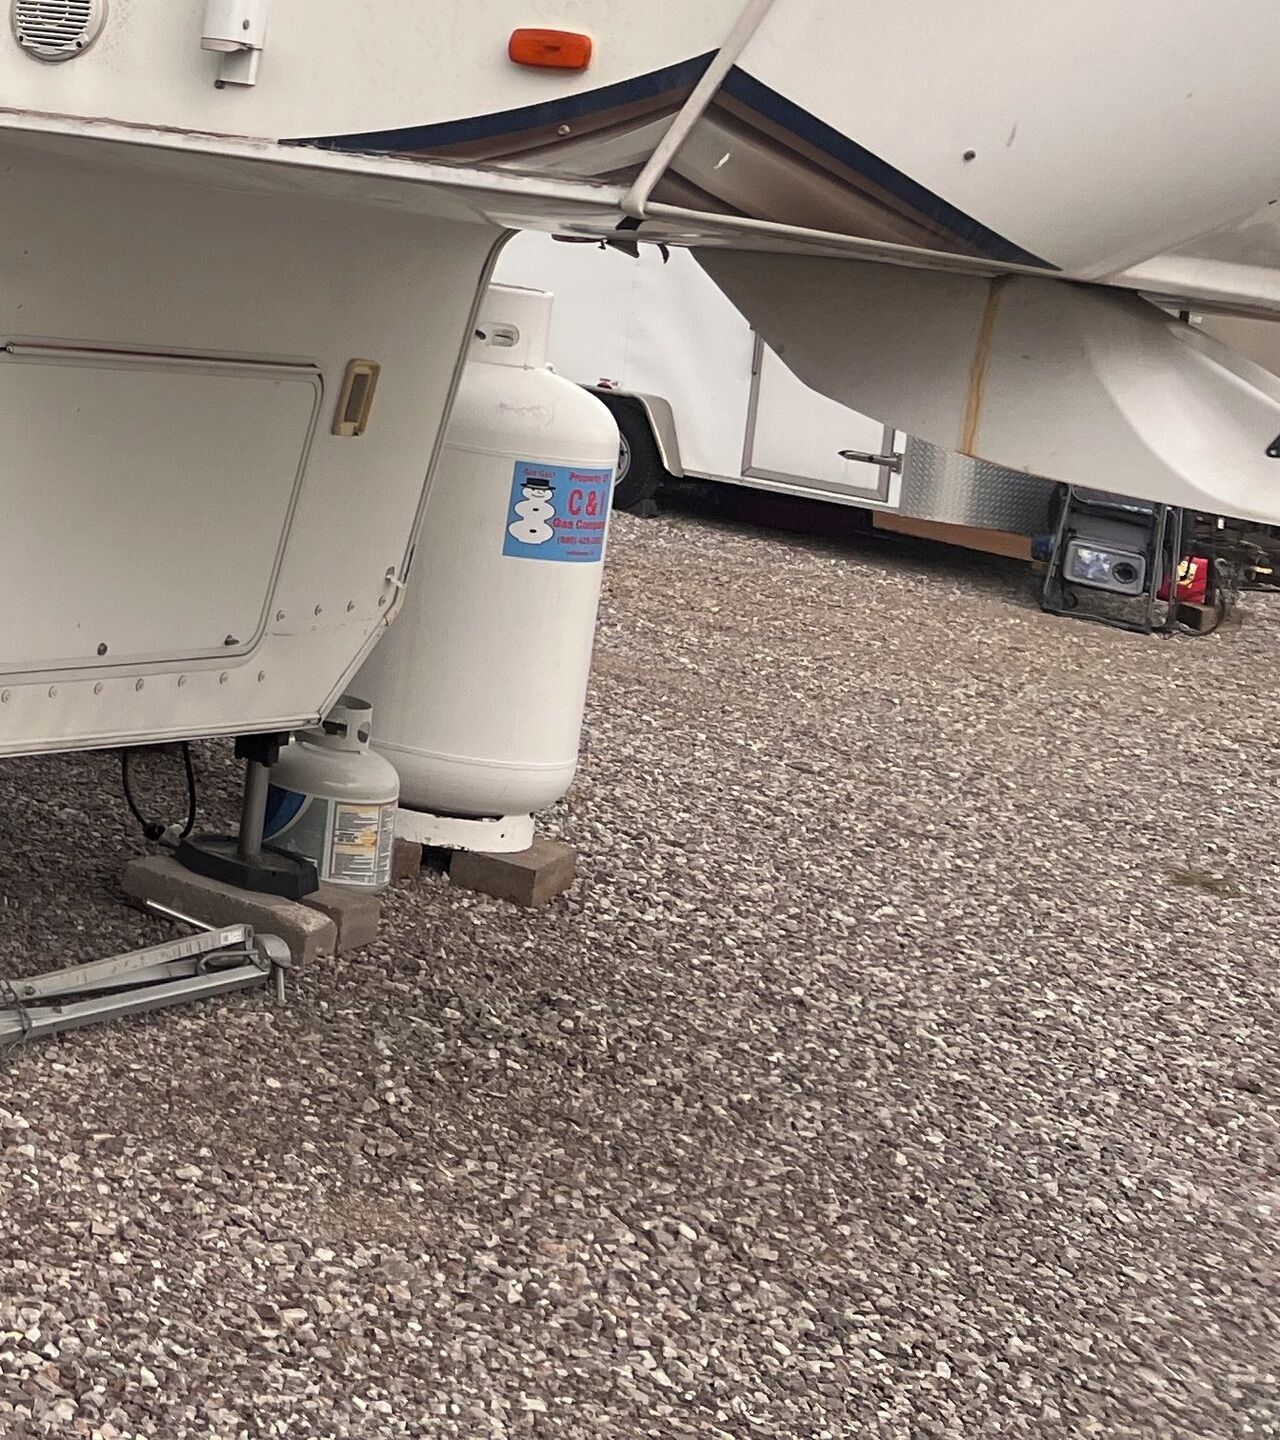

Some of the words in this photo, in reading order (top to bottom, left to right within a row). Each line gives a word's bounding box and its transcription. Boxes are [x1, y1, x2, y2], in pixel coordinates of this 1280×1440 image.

[569, 488, 583, 516] C
[585, 490, 597, 516] &
[552, 517, 573, 529] Gas
